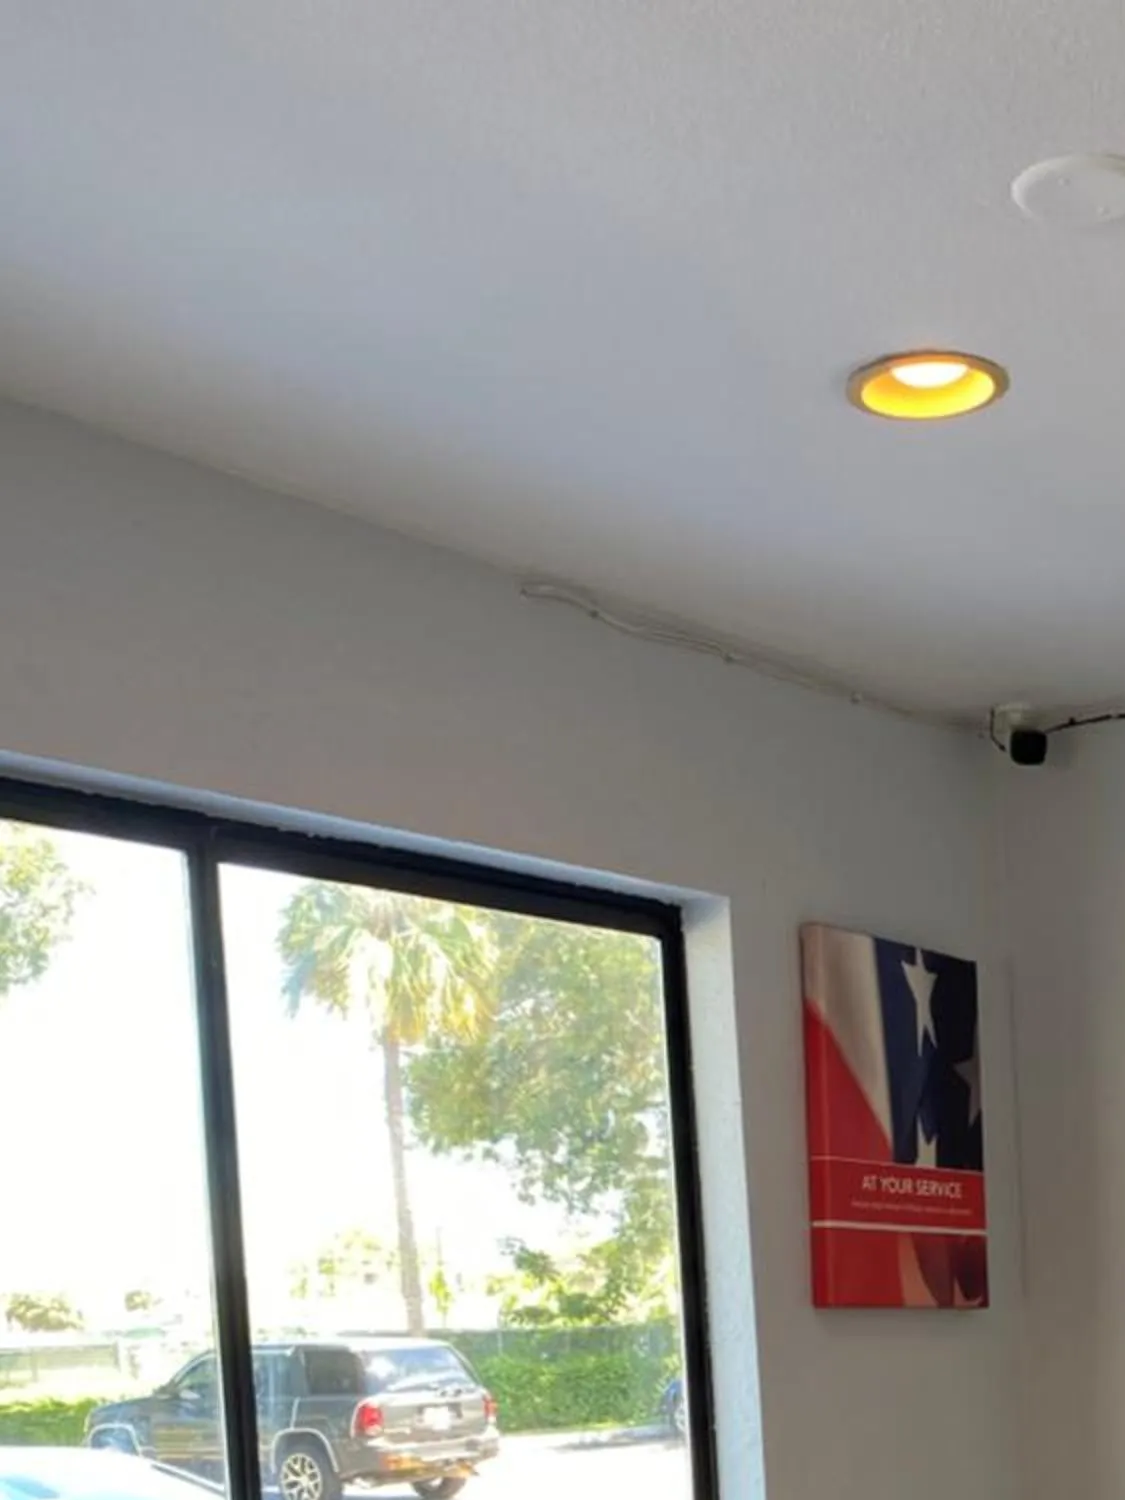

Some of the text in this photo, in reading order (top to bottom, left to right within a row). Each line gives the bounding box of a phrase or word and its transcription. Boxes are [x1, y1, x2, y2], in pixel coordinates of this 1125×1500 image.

[862, 1175, 962, 1198] AT YOUR SERVICE
